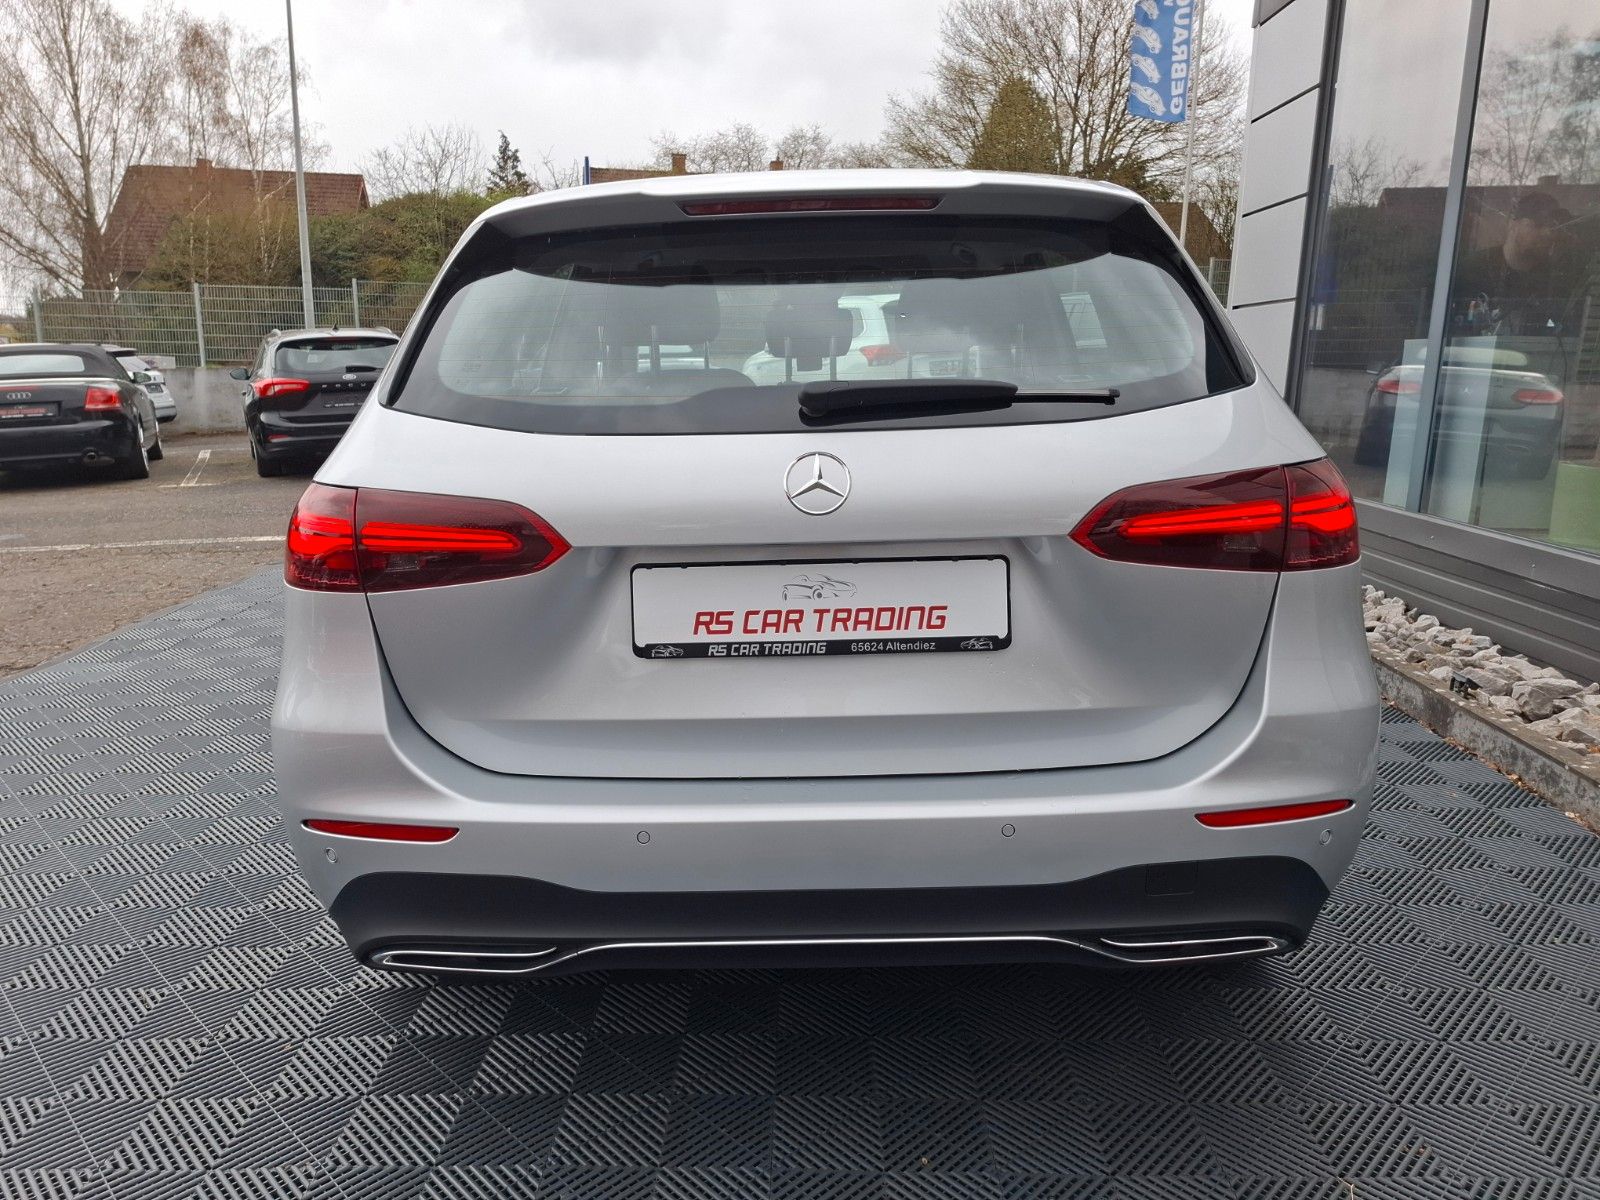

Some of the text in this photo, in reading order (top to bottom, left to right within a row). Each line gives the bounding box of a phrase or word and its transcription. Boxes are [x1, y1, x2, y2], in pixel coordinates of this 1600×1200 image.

[693, 605, 948, 635] RS CAR TRADING
[708, 642, 827, 656] RS CAR TRADING
[851, 640, 936, 653] 65624 Altendiez
